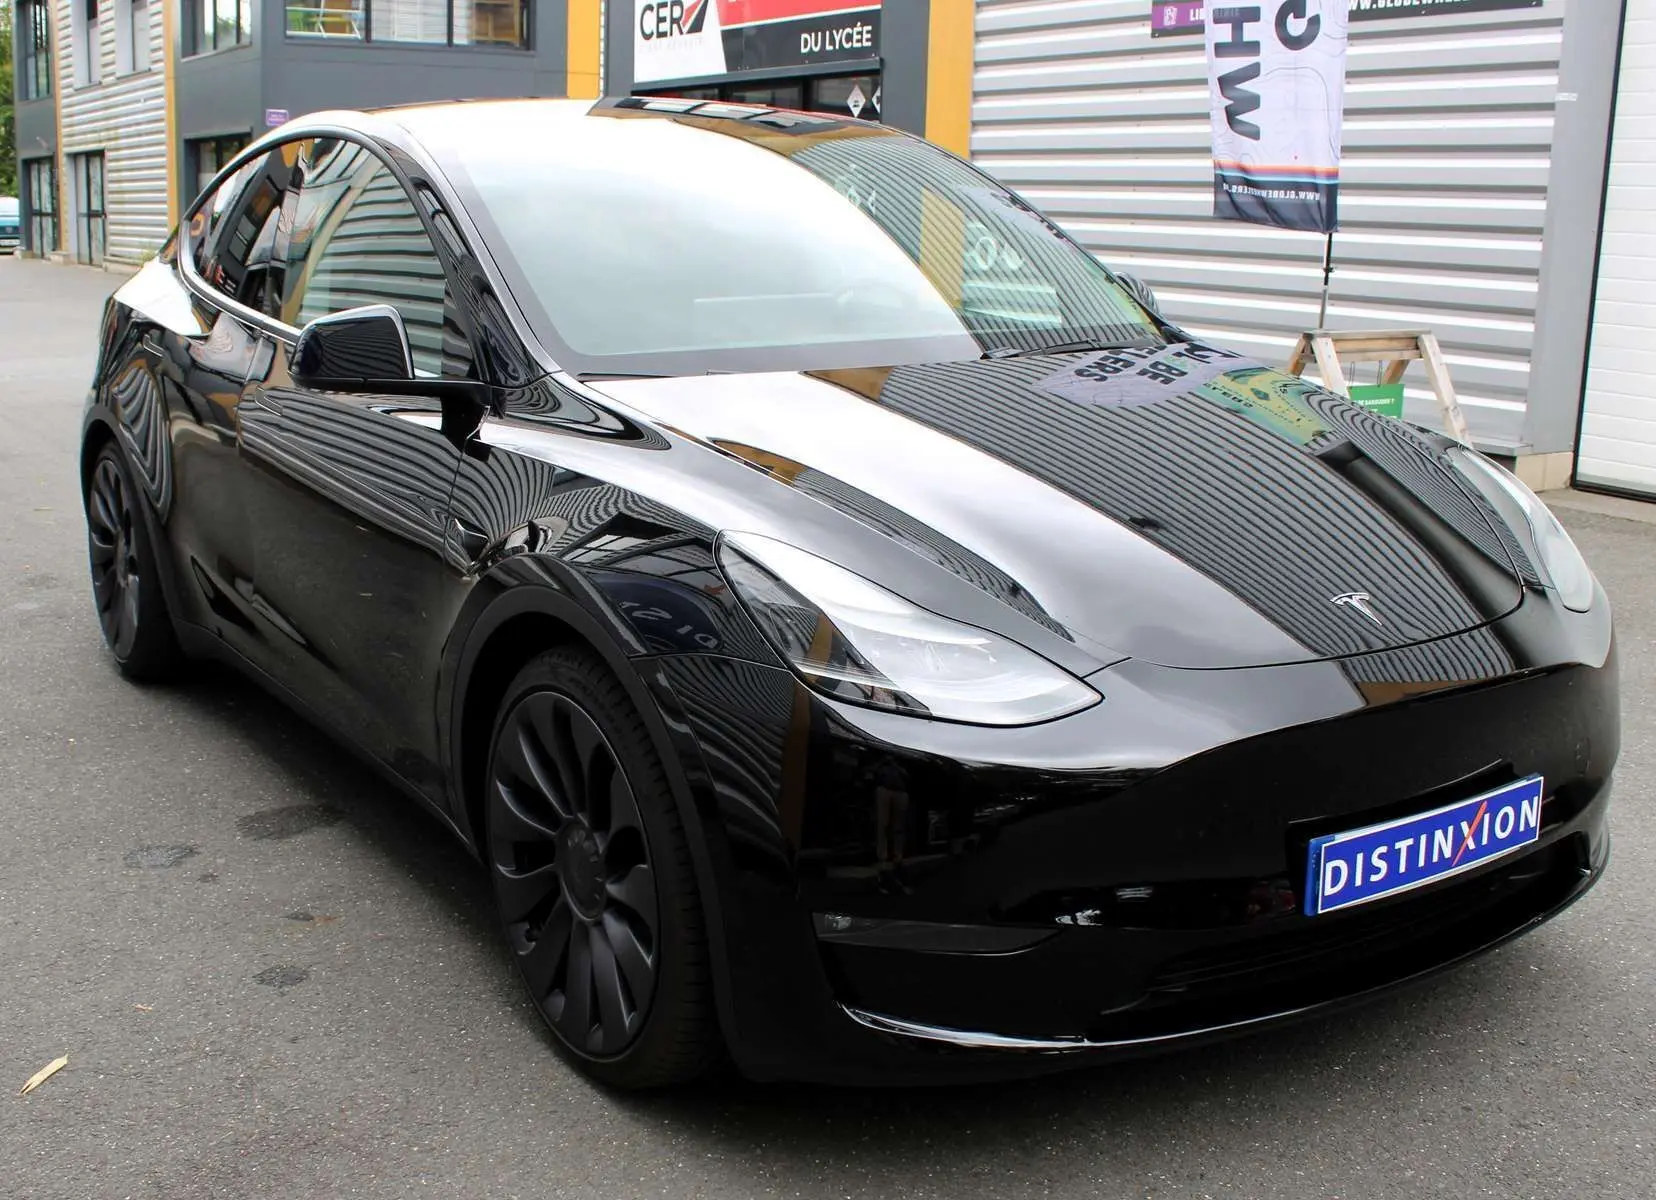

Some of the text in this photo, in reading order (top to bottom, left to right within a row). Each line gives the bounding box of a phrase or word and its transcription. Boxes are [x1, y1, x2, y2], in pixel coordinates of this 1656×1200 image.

[640, 0, 684, 40] CER
[800, 21, 873, 53] DU LYCÉE
[1324, 796, 1539, 896] DISTINXION
